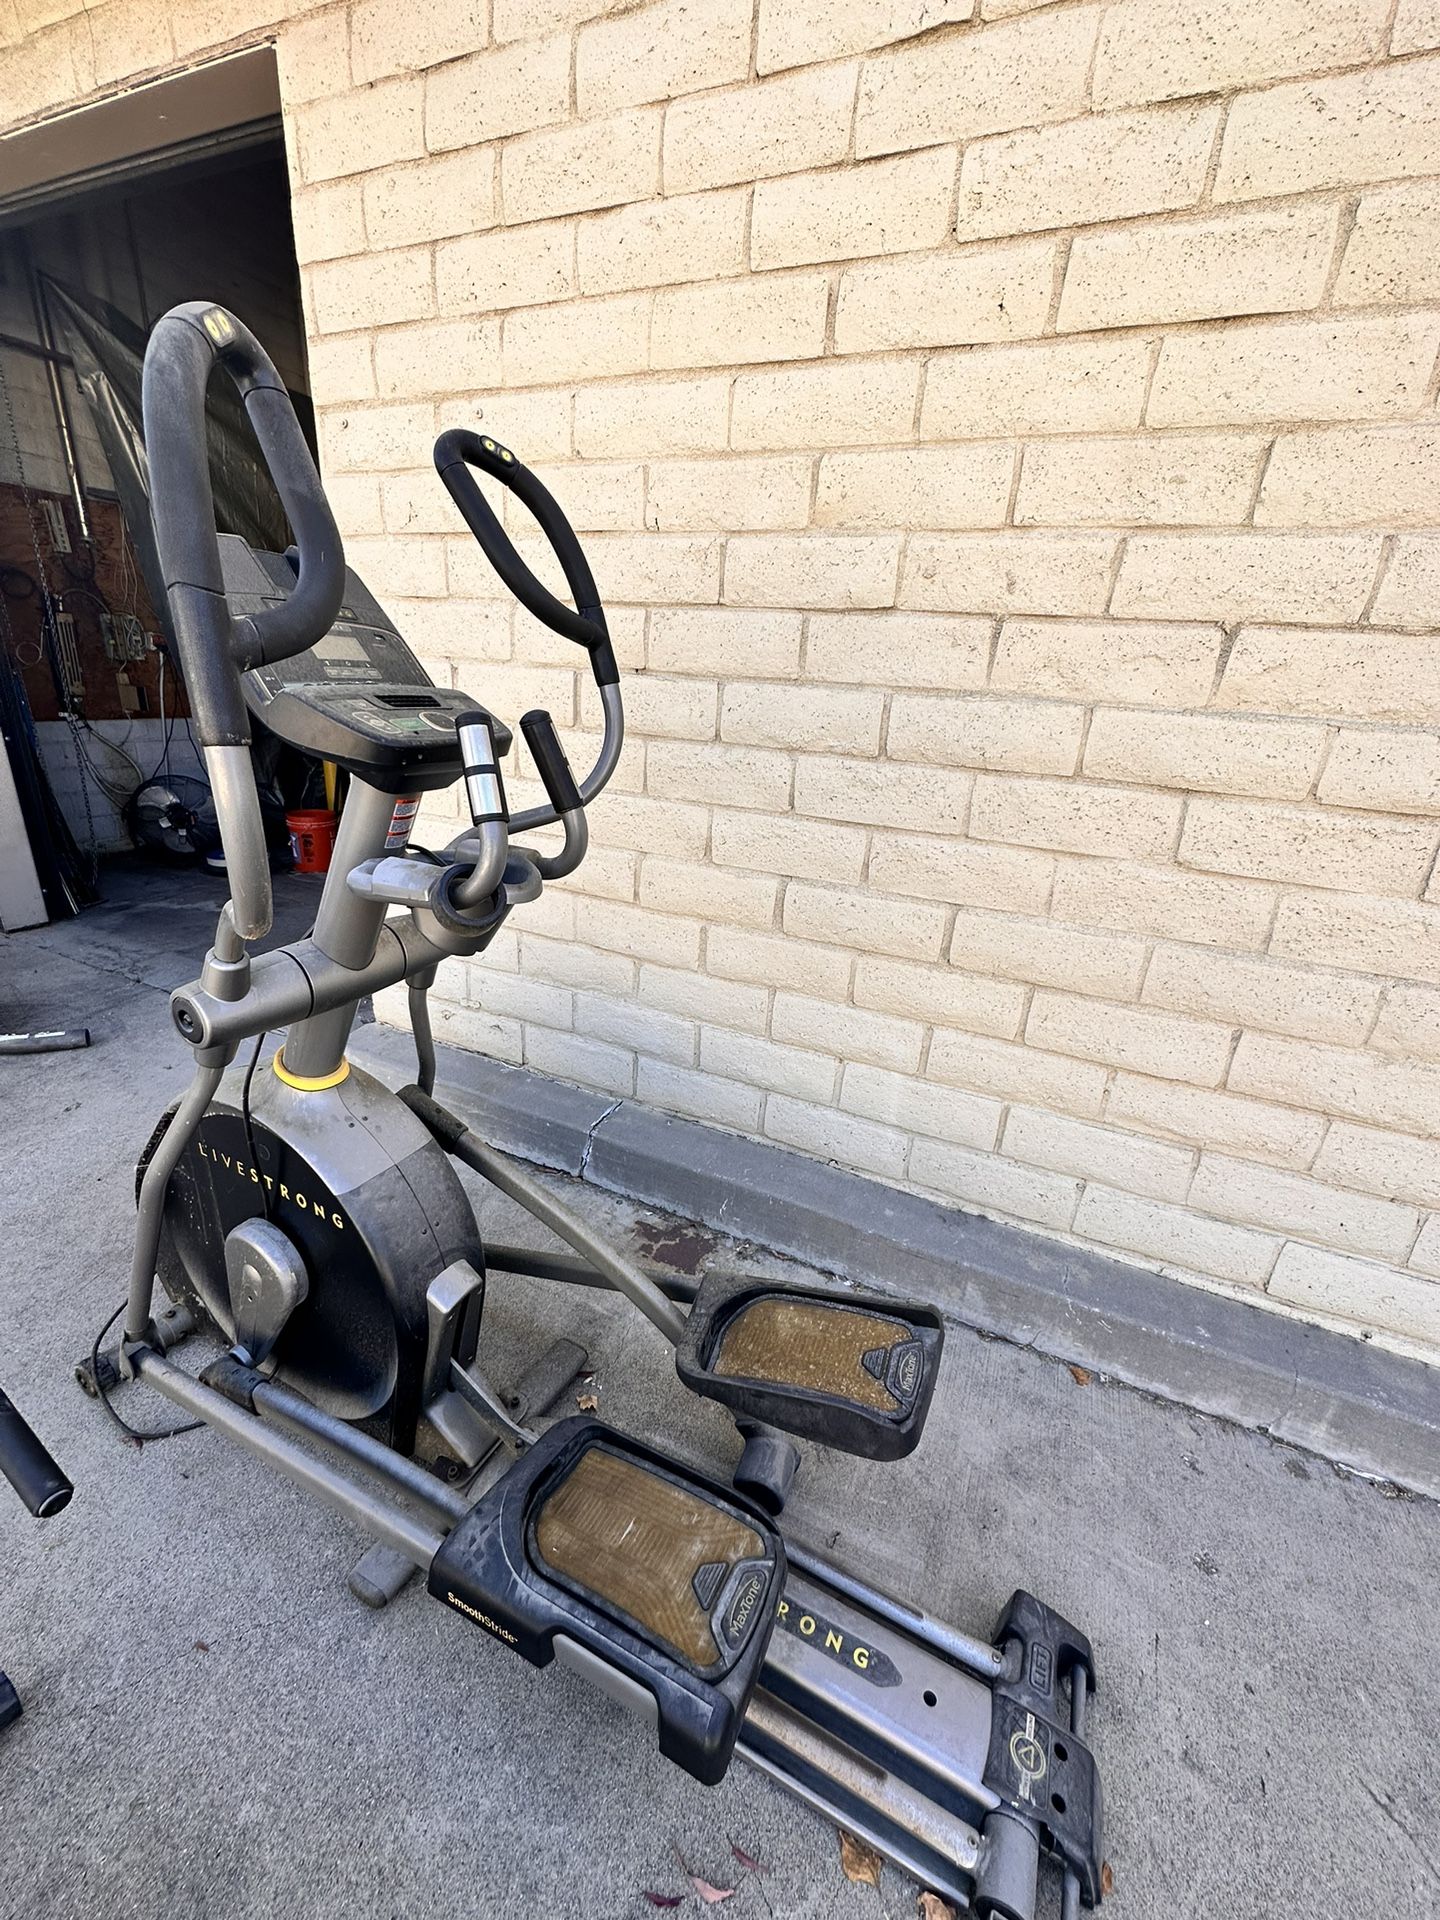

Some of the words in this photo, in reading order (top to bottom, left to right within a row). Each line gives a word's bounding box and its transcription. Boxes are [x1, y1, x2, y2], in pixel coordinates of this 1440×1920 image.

[198, 1142, 344, 1229] LIVESTRONG
[902, 1354, 917, 1391] MaxTone
[447, 1591, 515, 1643] SmoothStride
[730, 1579, 760, 1637] MaxTone
[1034, 1647, 1047, 1690] LIFT
